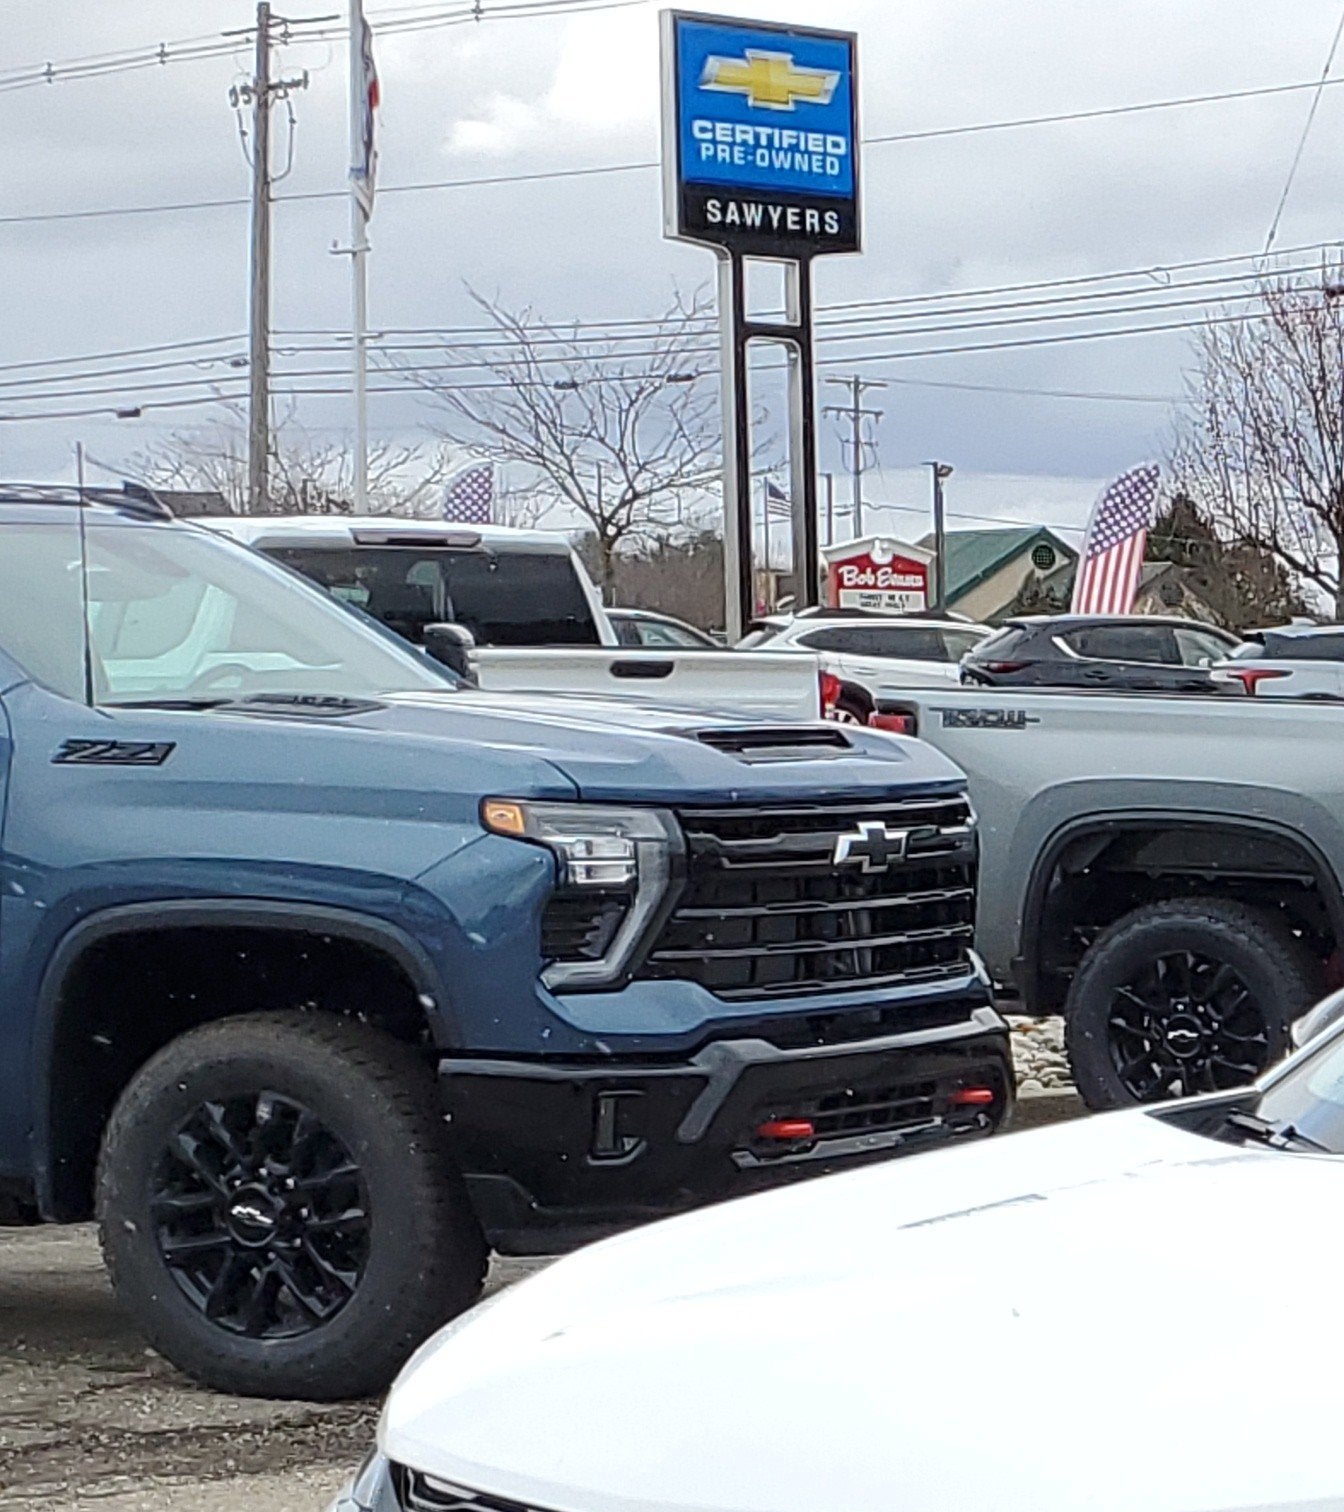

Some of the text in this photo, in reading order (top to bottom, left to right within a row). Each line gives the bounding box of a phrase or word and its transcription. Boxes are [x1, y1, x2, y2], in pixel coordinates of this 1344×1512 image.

[692, 119, 846, 156] CERTIFIED
[701, 142, 840, 176] PRE-OWNED
[706, 199, 840, 234] SAWYERS
[838, 565, 875, 587] Bob
